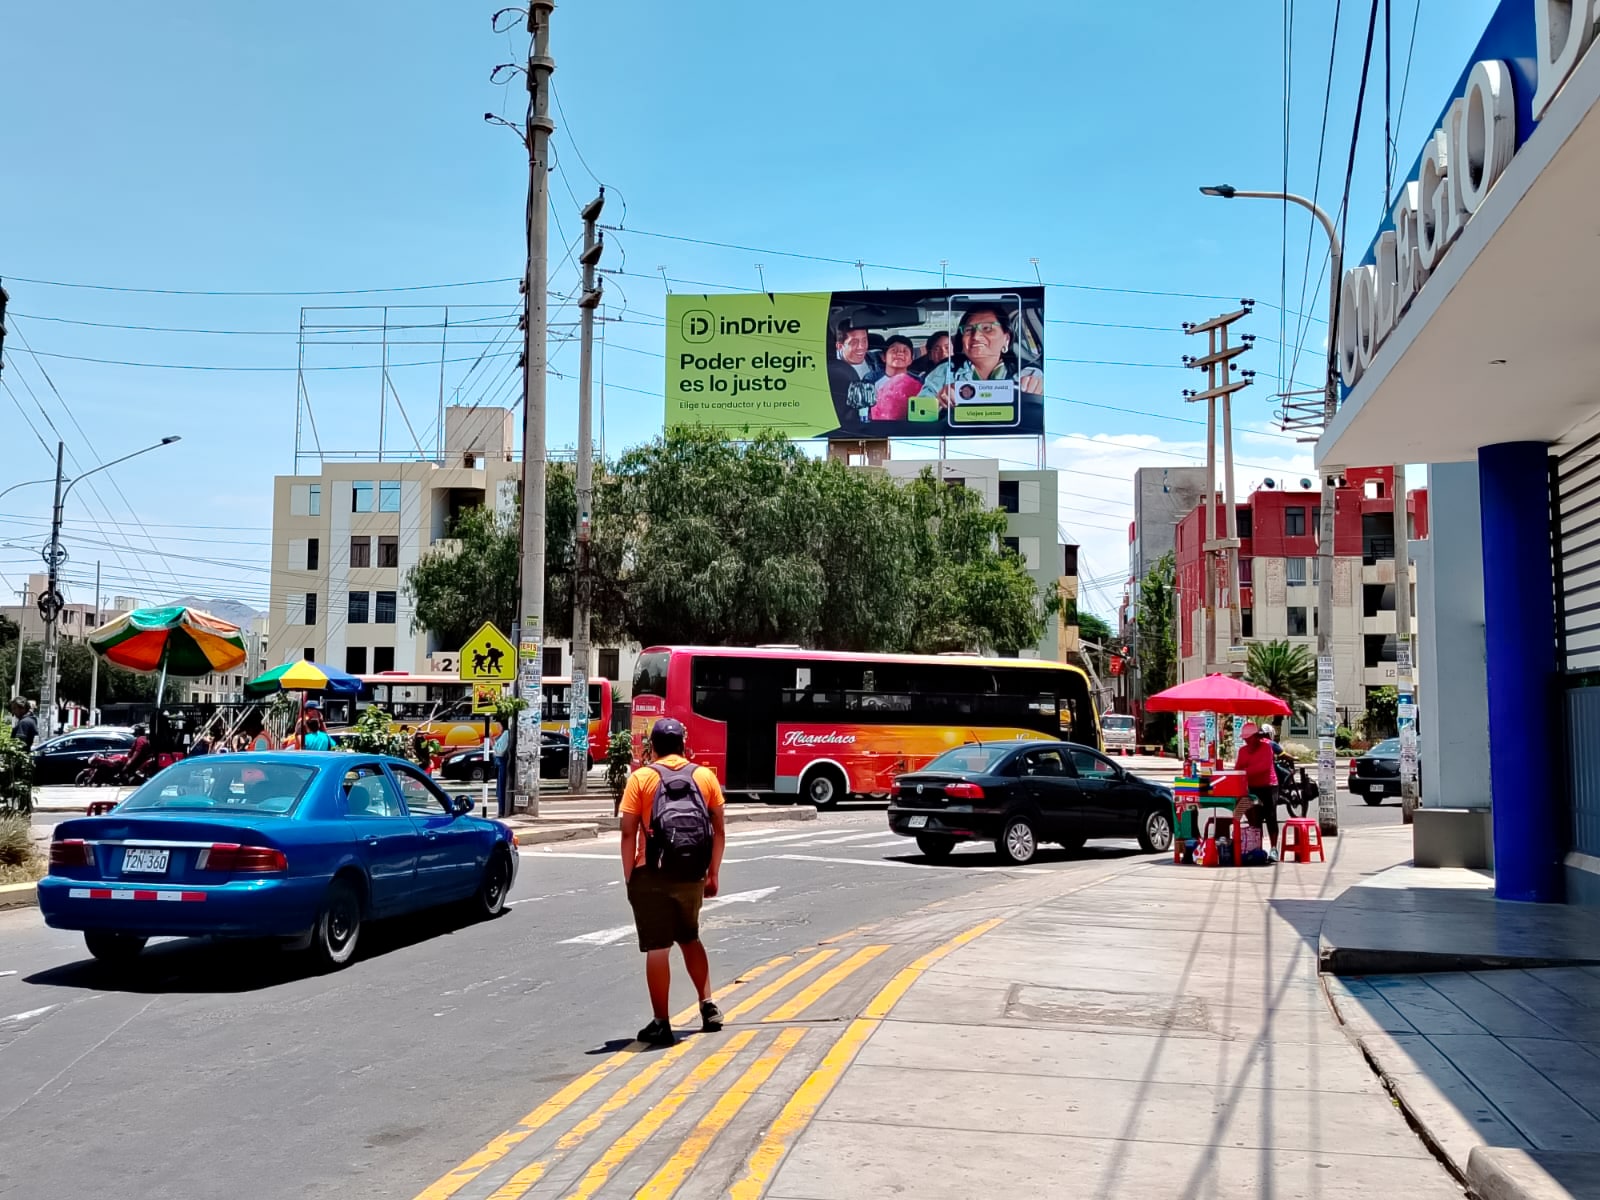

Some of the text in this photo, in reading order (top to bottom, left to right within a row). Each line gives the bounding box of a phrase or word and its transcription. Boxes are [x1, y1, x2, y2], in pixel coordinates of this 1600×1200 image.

[1340, 60, 1515, 388] COLEGIO
[720, 314, 801, 335] inDrive
[680, 351, 816, 373] Poder elegir,
[679, 374, 787, 396] es lo justo
[679, 401, 699, 410] Elige
[701, 401, 710, 409] tu
[711, 400, 754, 409] conductor
[763, 400, 771, 408] tu
[773, 400, 800, 409] precio
[782, 731, 856, 747] Huanchaco
[126, 855, 167, 869] T2N-360
